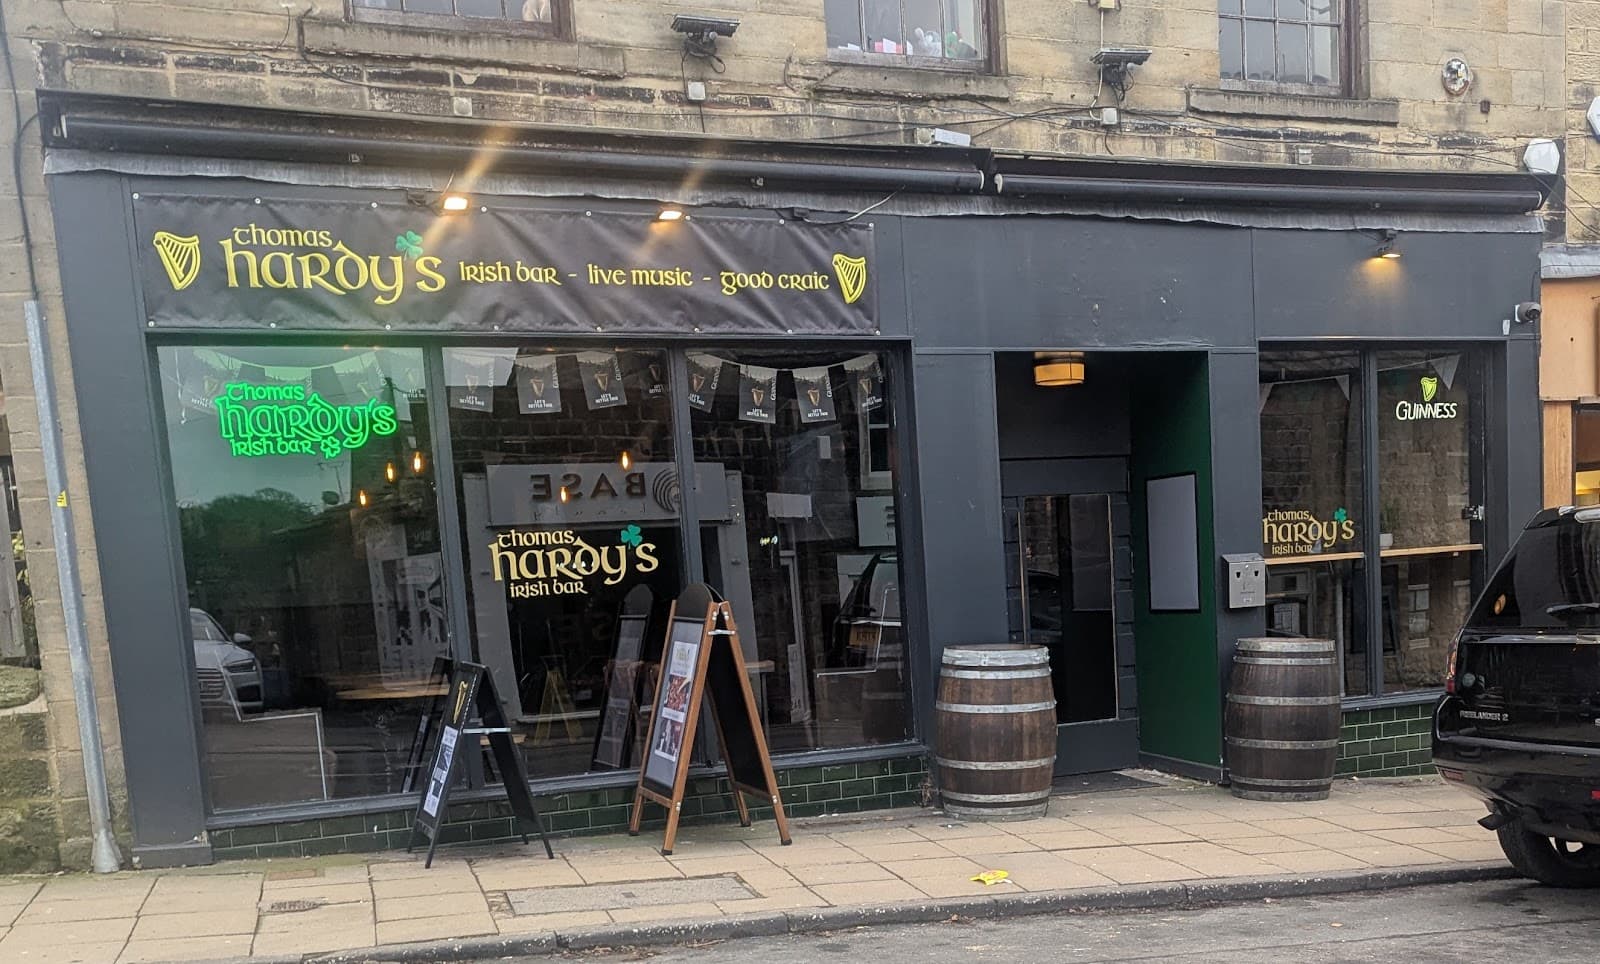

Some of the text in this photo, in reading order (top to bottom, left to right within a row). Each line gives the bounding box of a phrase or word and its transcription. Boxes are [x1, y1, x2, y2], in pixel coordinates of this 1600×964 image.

[515, 260, 562, 286] bar
[586, 263, 627, 286] live
[630, 267, 694, 287] music
[720, 270, 774, 296] good
[777, 271, 831, 292] craic
[1396, 400, 1458, 421] GUINNESS
[277, 437, 316, 455] bar
[552, 578, 588, 596] bar
